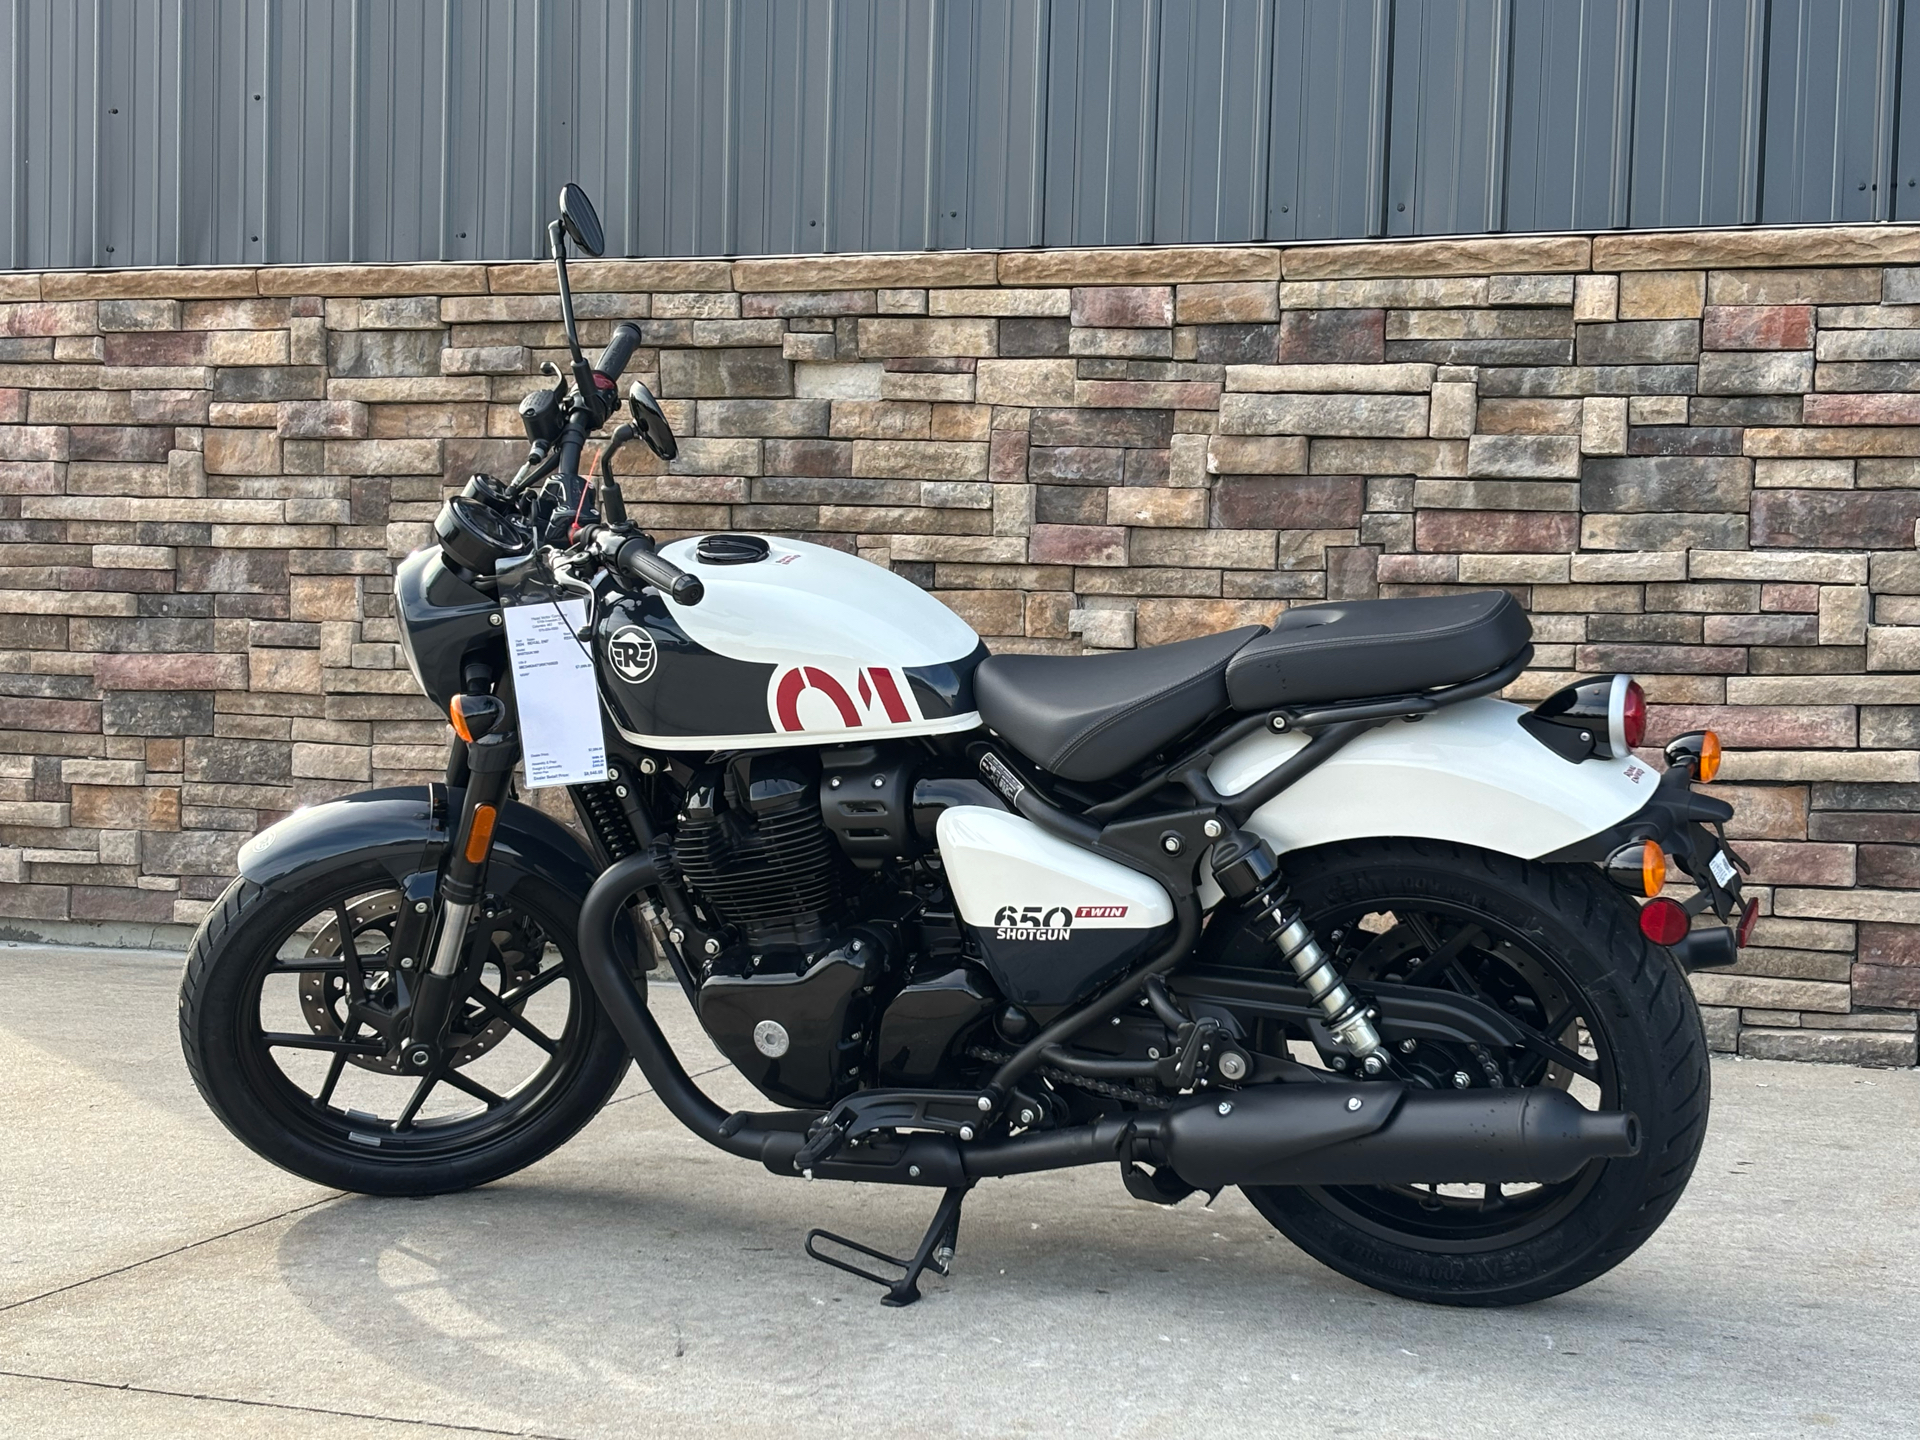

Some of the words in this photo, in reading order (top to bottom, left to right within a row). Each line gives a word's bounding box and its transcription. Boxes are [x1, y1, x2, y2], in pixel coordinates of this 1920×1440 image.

[776, 666, 912, 732] 01
[994, 905, 1073, 928] 650
[1080, 907, 1124, 917] TWIN
[996, 928, 1071, 941] SHOTGUN
